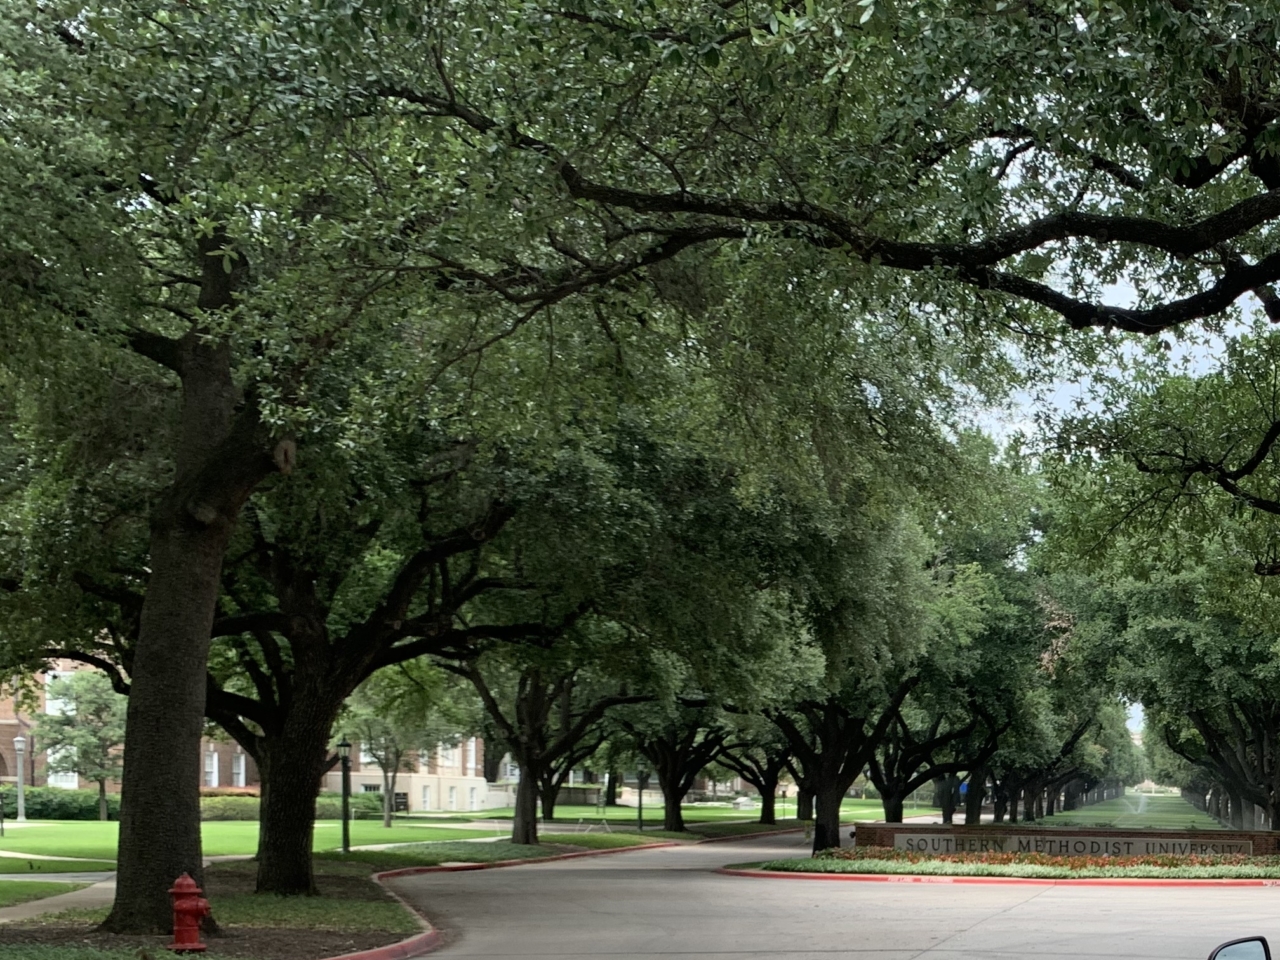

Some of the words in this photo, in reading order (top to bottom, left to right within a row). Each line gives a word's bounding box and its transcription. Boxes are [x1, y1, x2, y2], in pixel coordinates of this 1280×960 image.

[906, 838, 1004, 851] SOUTHERN
[1018, 839, 1134, 855] METHODIST
[1146, 842, 1243, 855] UNIVERSITY
